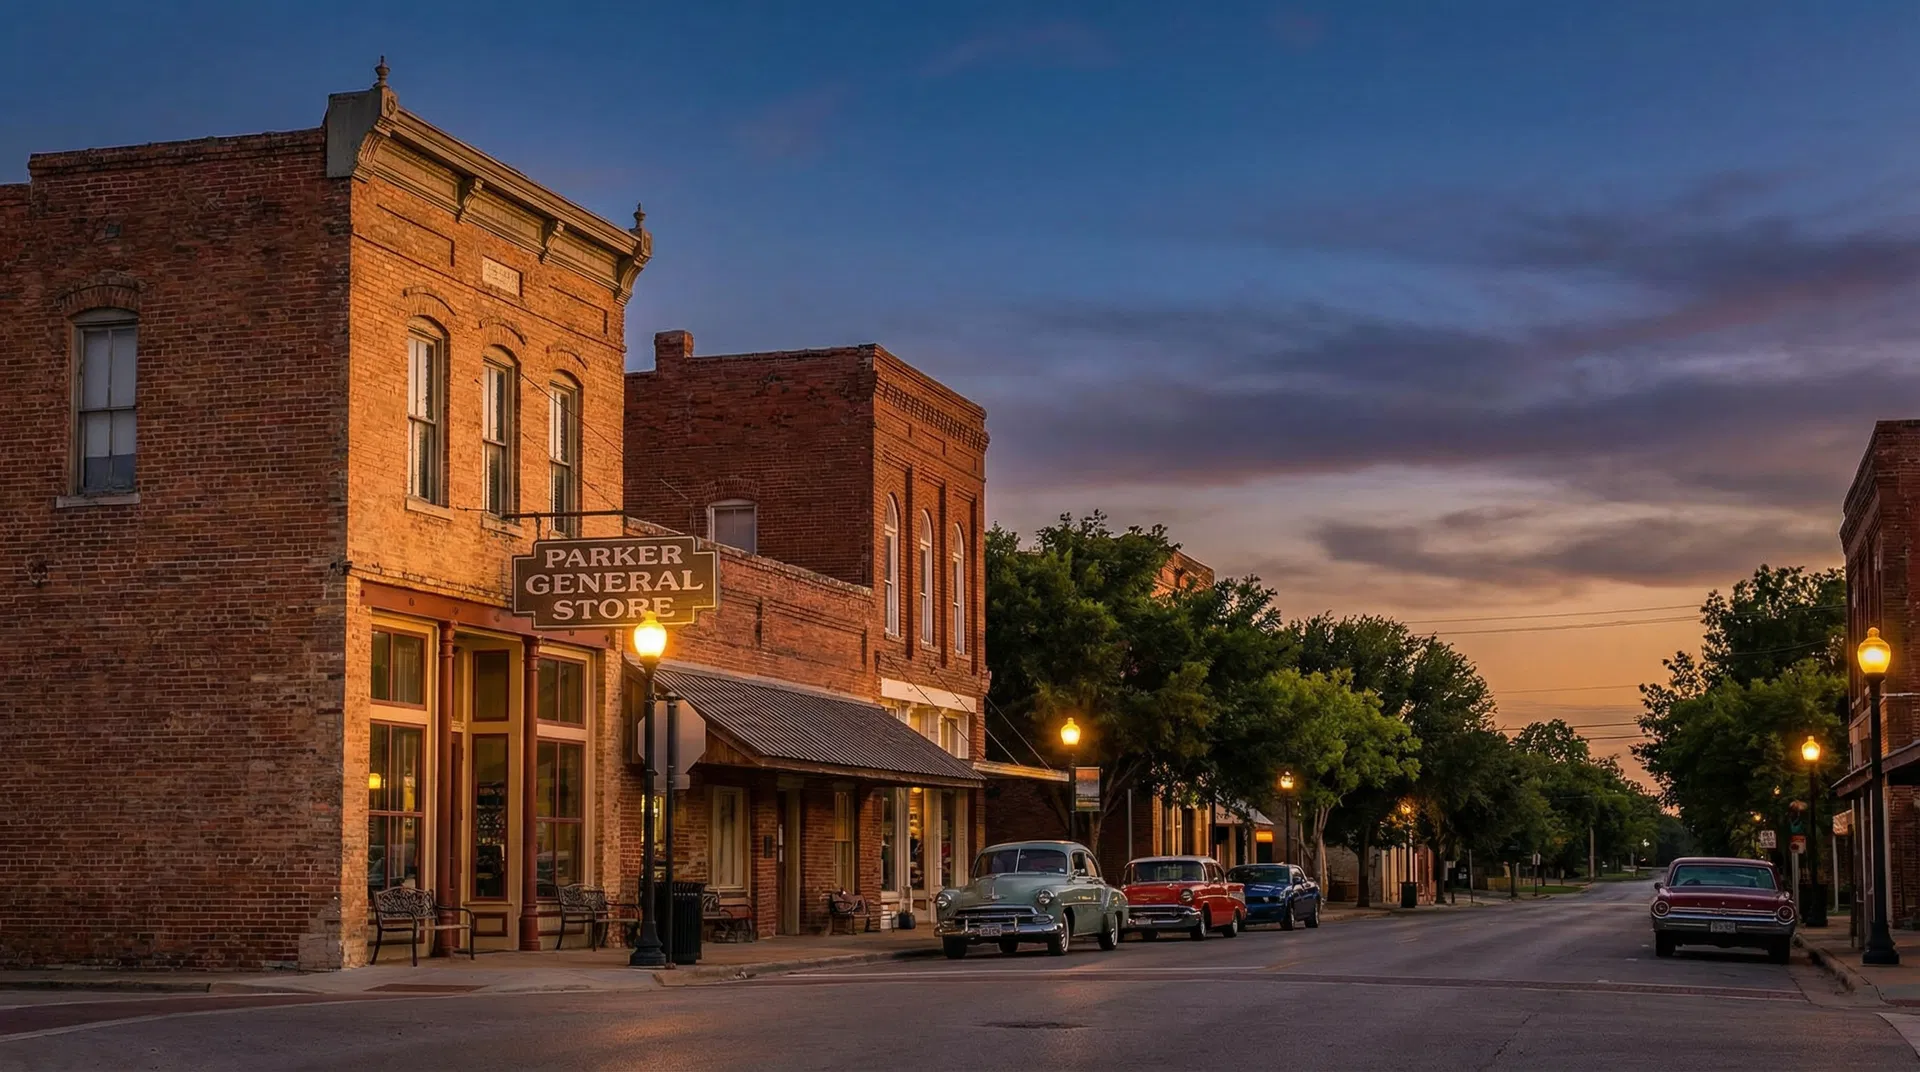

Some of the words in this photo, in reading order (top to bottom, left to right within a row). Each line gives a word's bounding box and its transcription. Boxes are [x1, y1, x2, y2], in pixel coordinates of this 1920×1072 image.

[545, 545, 683, 568] PARKER
[525, 570, 704, 594] GENERAL
[552, 597, 676, 620] STORE
